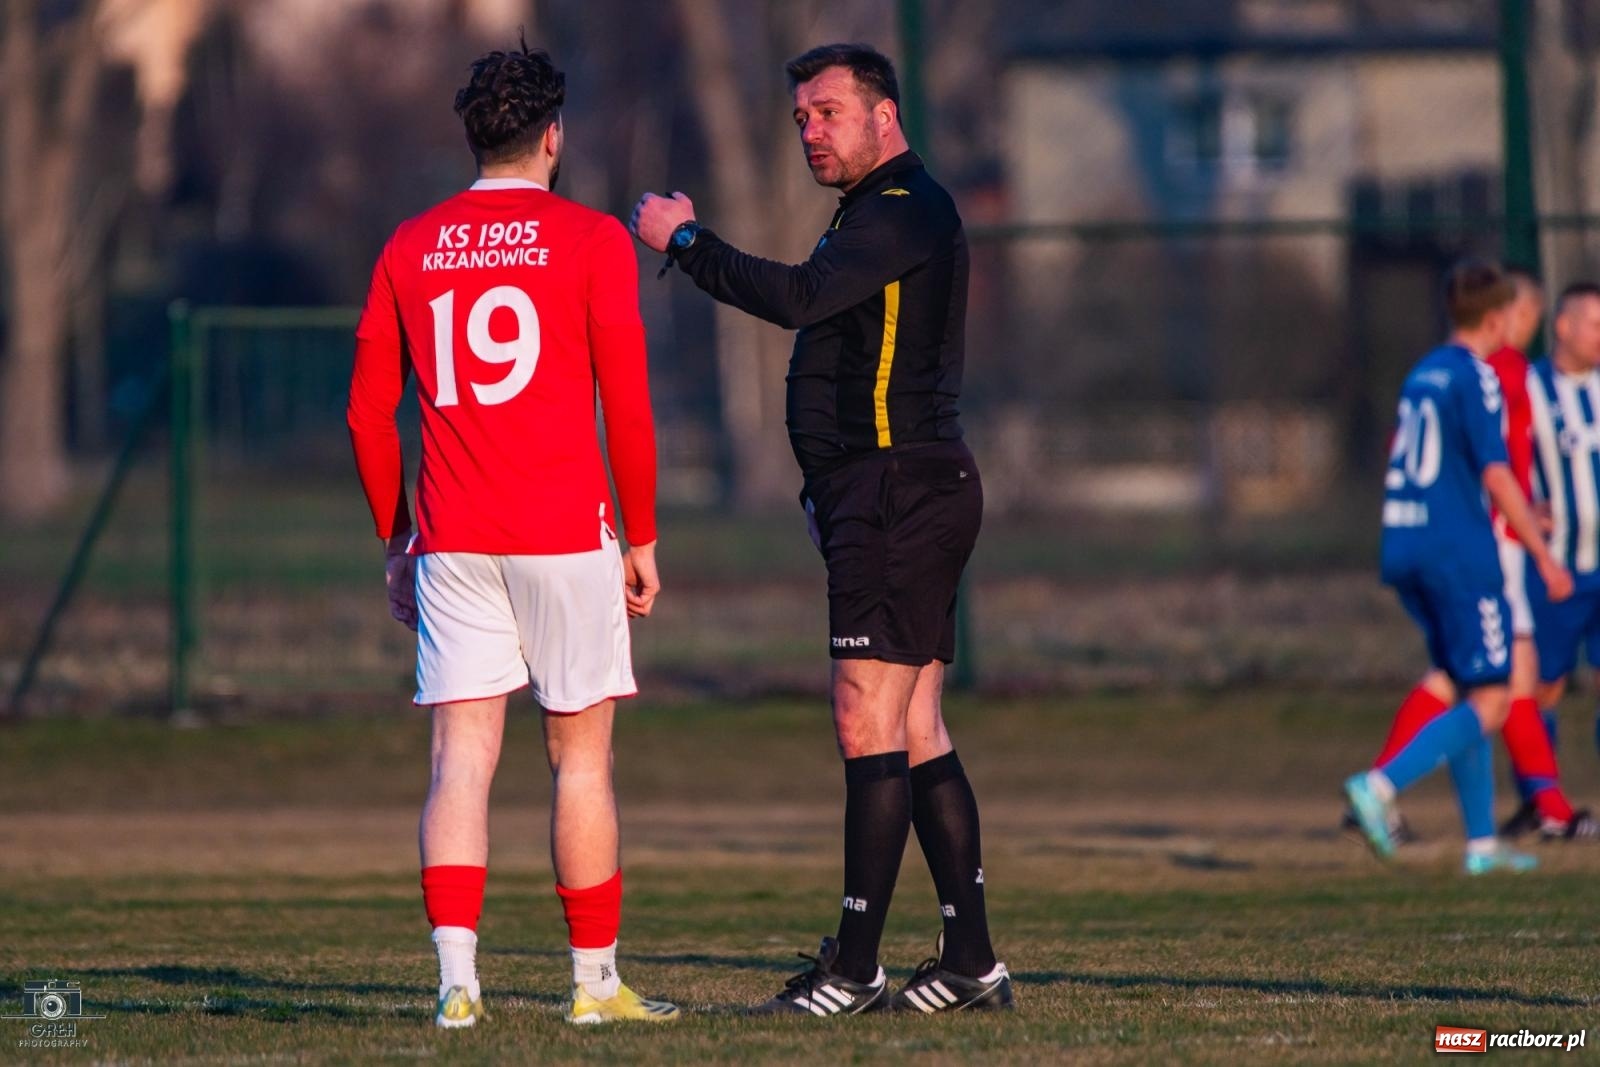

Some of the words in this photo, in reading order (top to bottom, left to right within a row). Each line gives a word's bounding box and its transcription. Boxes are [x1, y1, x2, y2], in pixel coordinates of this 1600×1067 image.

[437, 224, 471, 249] KS
[477, 221, 539, 247] 1905
[422, 248, 549, 271] KRZANOWICE
[428, 285, 541, 407] 19
